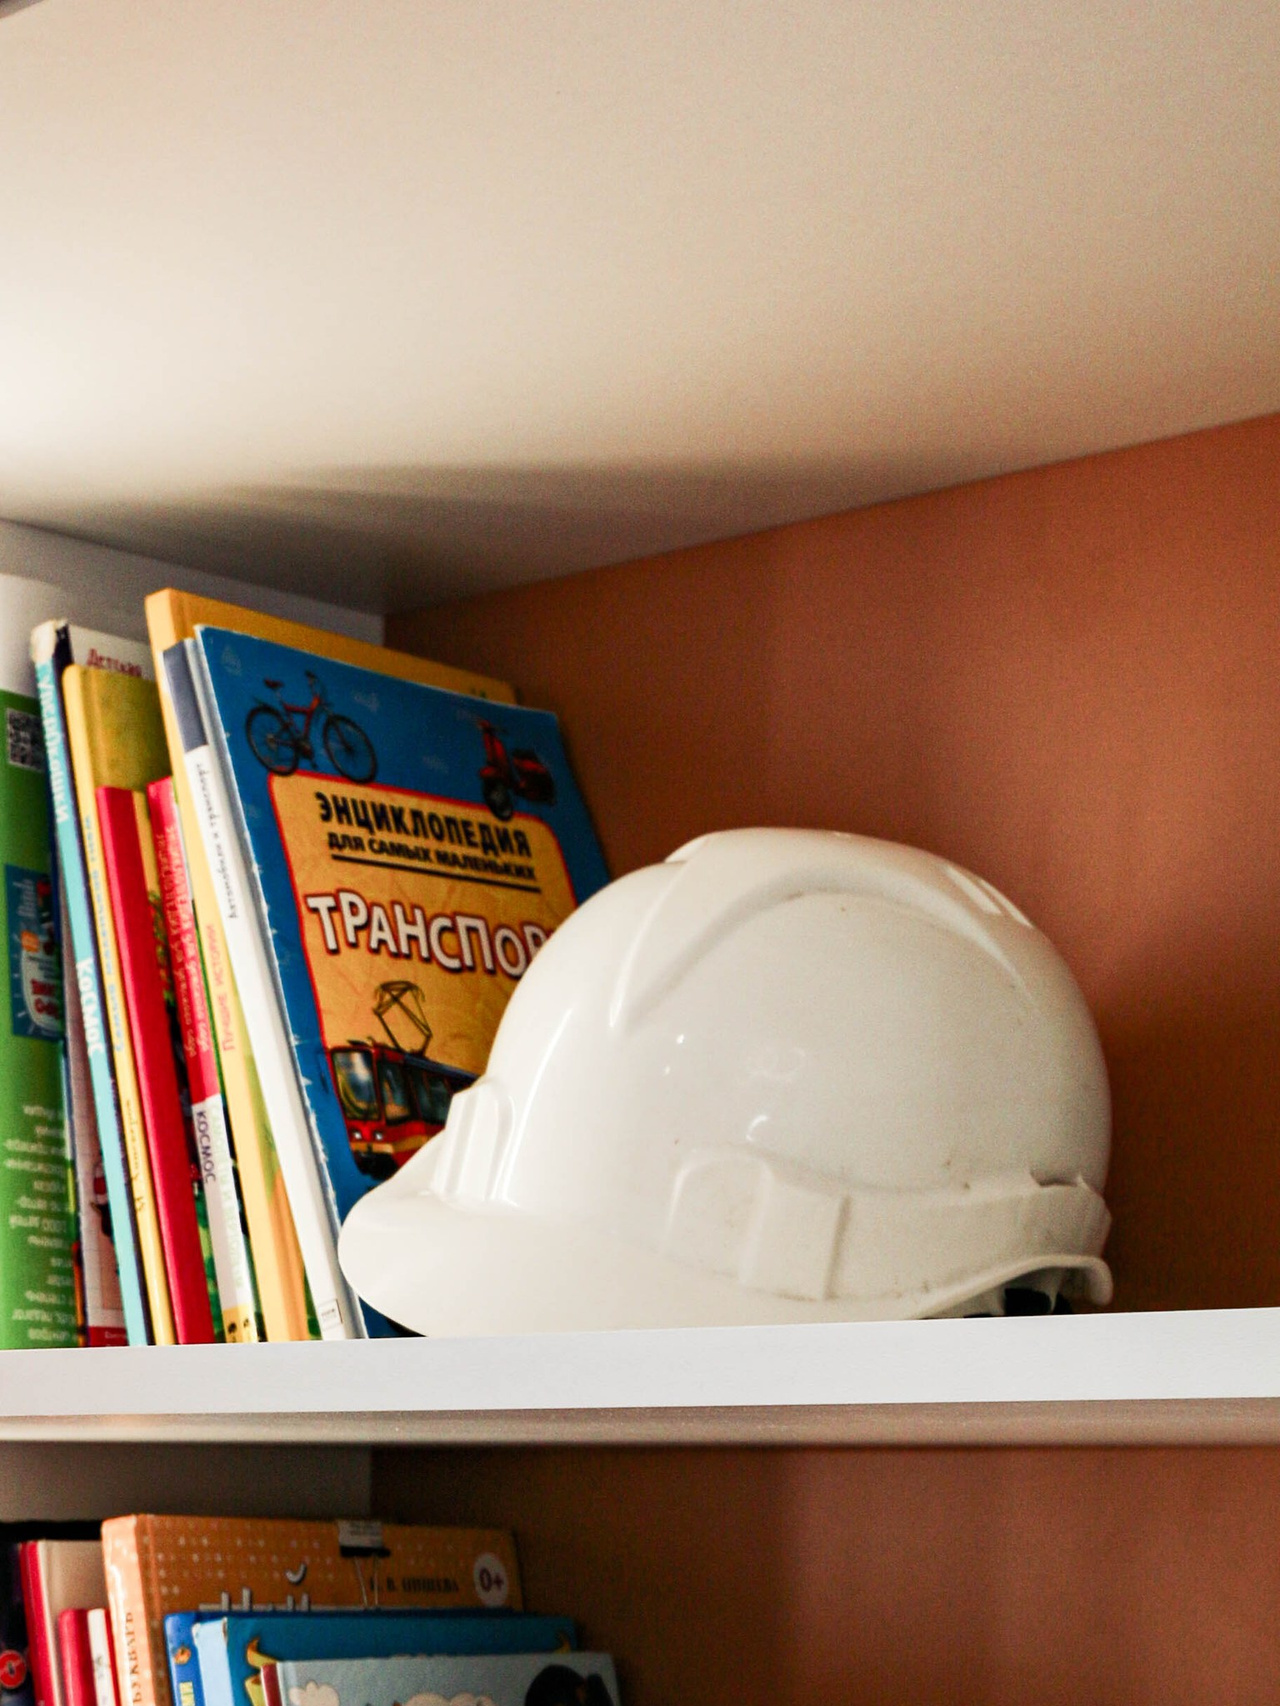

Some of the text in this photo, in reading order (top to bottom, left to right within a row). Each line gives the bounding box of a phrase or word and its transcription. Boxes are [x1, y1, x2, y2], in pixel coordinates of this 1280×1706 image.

[314, 791, 533, 859] ЭНЦИКЛОПЕДИЯ
[328, 832, 537, 881] ДЛЯ САМЫХ МАЛЕНЬКИХ
[305, 889, 552, 981] ТРАНСПОР
[193, 1110, 217, 1183] КОСМОС
[478, 1566, 504, 1593] 0+
